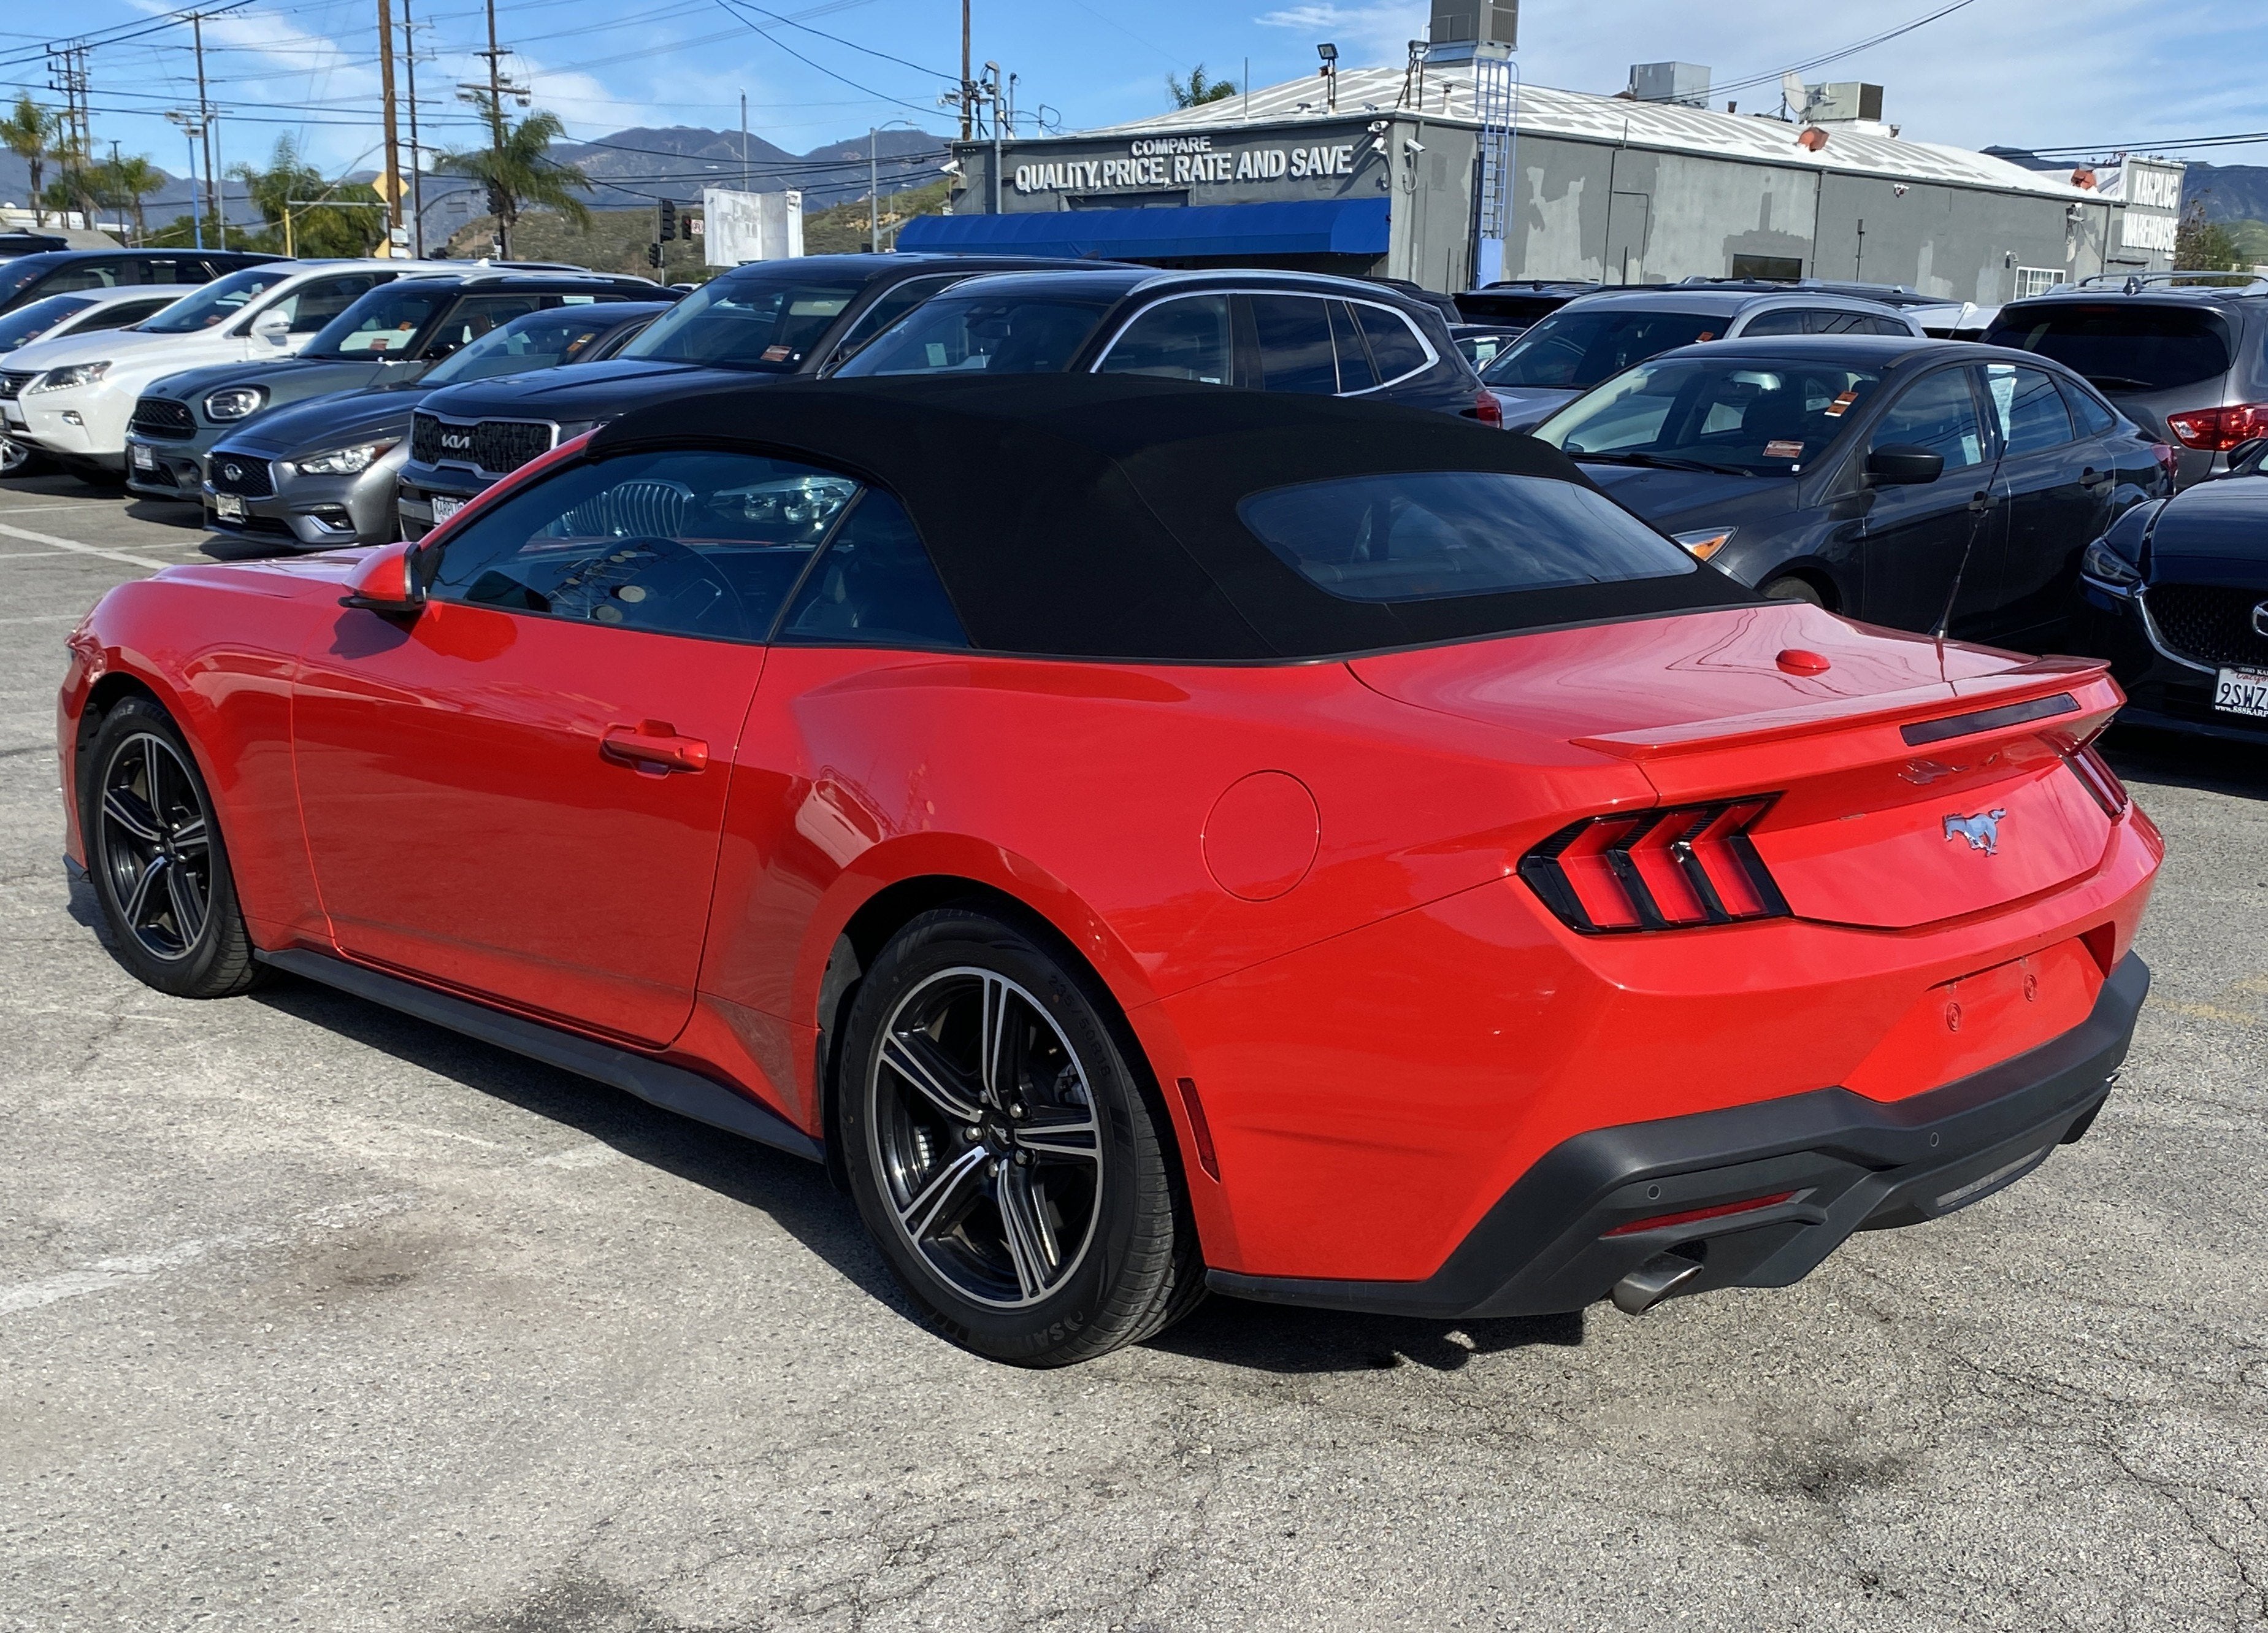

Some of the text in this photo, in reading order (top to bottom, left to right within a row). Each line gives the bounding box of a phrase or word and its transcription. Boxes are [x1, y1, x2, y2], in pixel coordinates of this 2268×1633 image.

[1131, 136, 1213, 156] COMPARE
[1174, 152, 1232, 183] RATE
[1236, 149, 1286, 180] AND
[1290, 145, 1353, 177] SAVE
[2121, 212, 2179, 252] WAREHOUSE
[2220, 682, 2268, 710] 9SWZ
